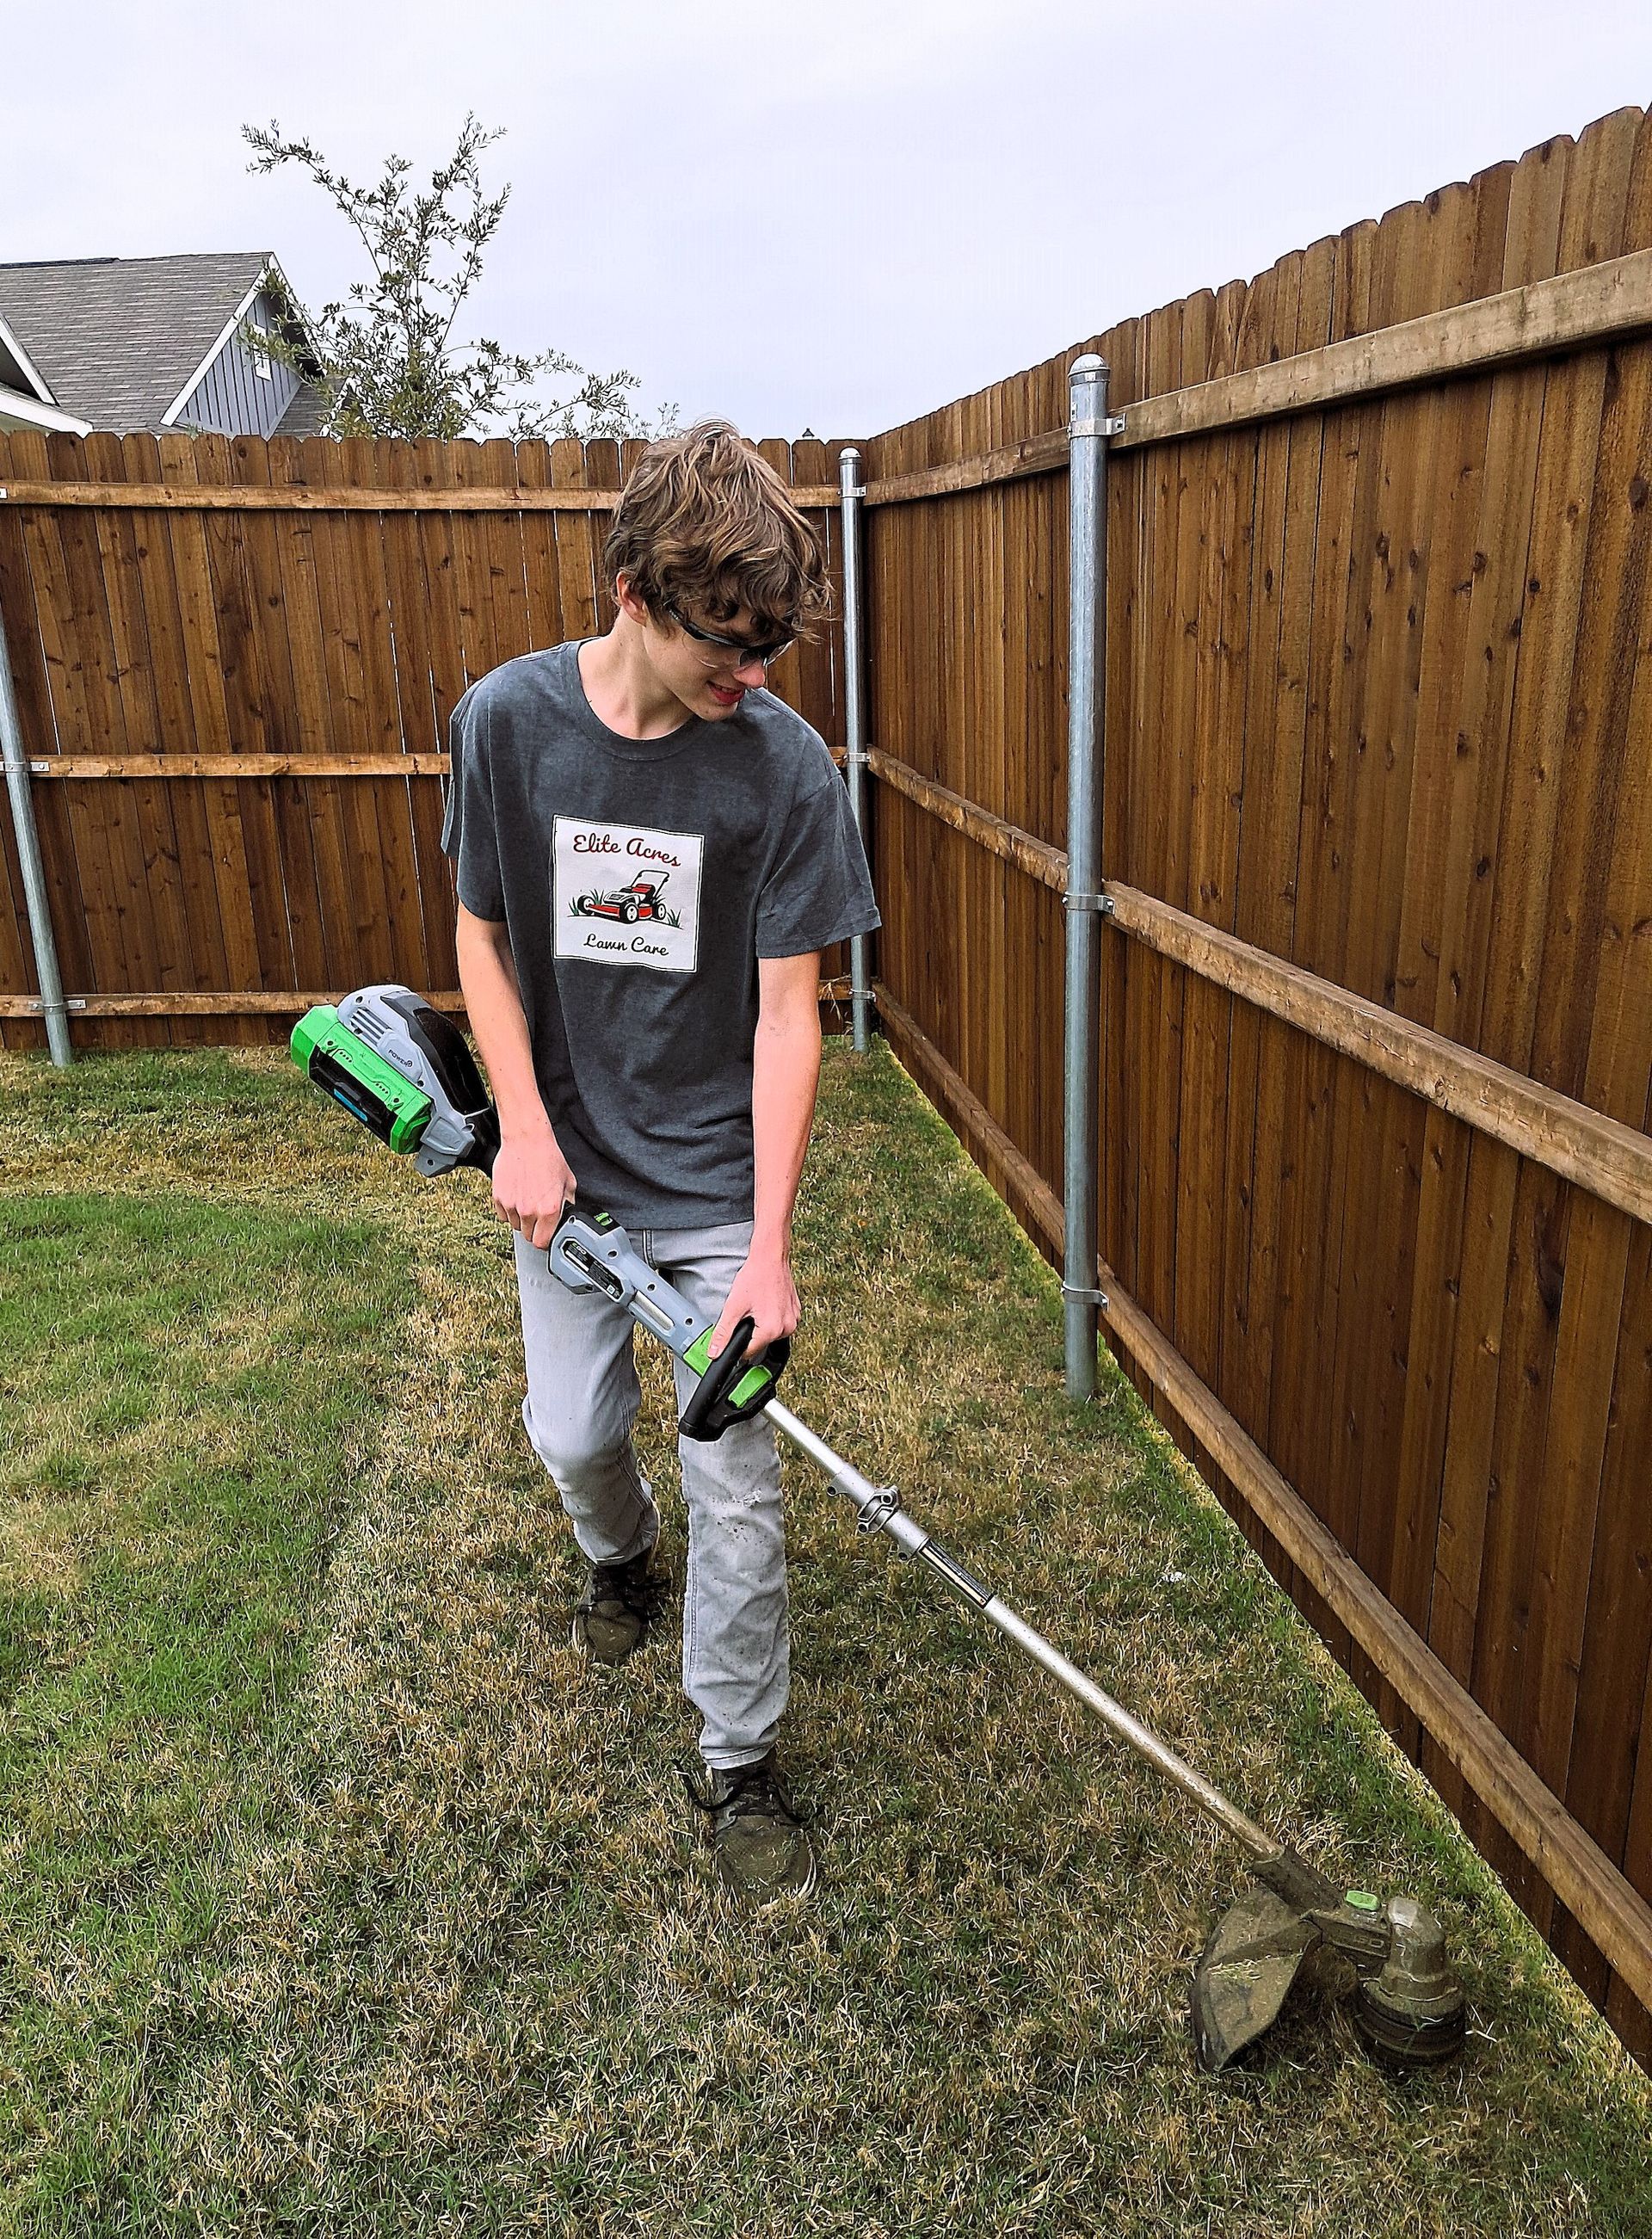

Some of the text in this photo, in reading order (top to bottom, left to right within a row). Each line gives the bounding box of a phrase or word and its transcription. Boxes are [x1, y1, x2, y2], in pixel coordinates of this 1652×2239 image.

[573, 832, 681, 867] Elite Acres
[583, 933, 669, 956] Lawn Care
